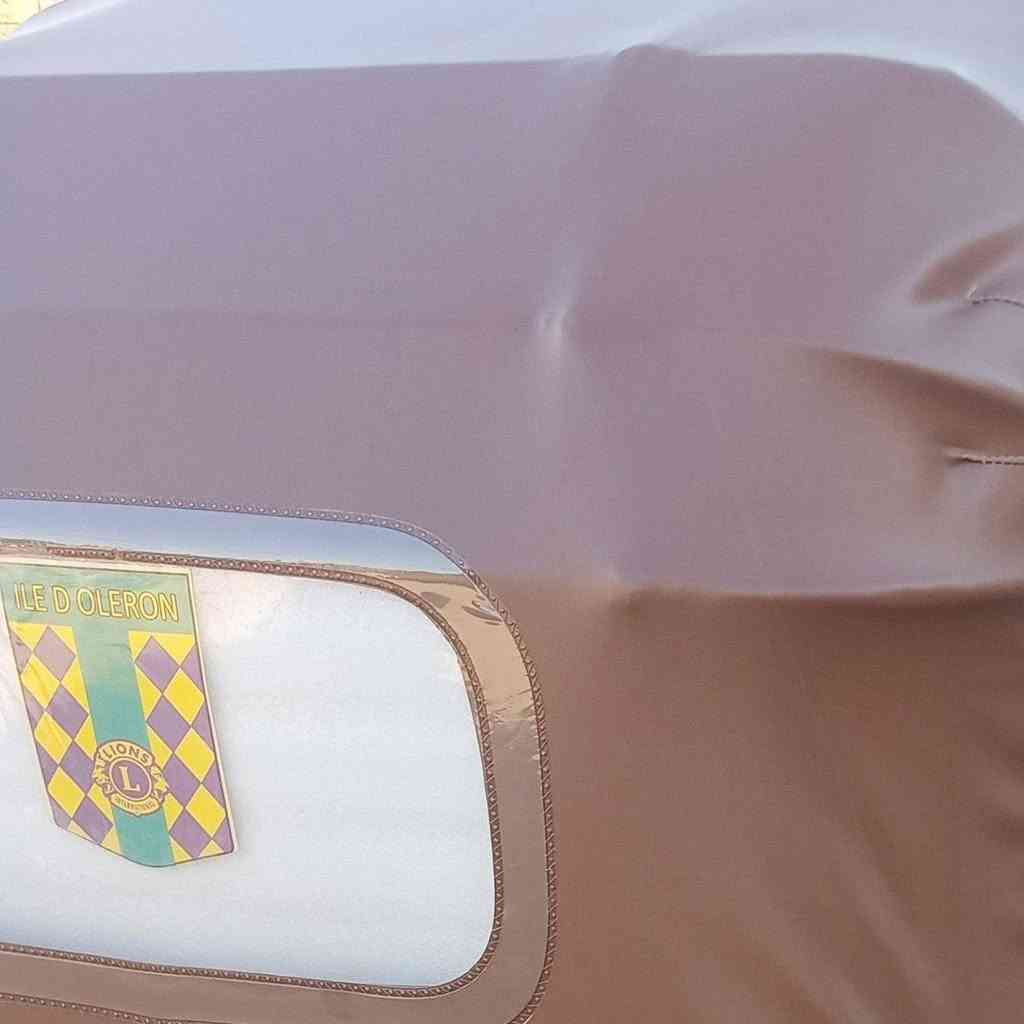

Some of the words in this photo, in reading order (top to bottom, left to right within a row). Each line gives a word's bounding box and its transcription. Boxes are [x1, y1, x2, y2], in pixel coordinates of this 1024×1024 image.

[14, 583, 48, 612] ILE
[52, 584, 70, 614] D
[77, 586, 179, 622] OLERON
[102, 743, 150, 764] LIONS
[118, 766, 141, 792] L
